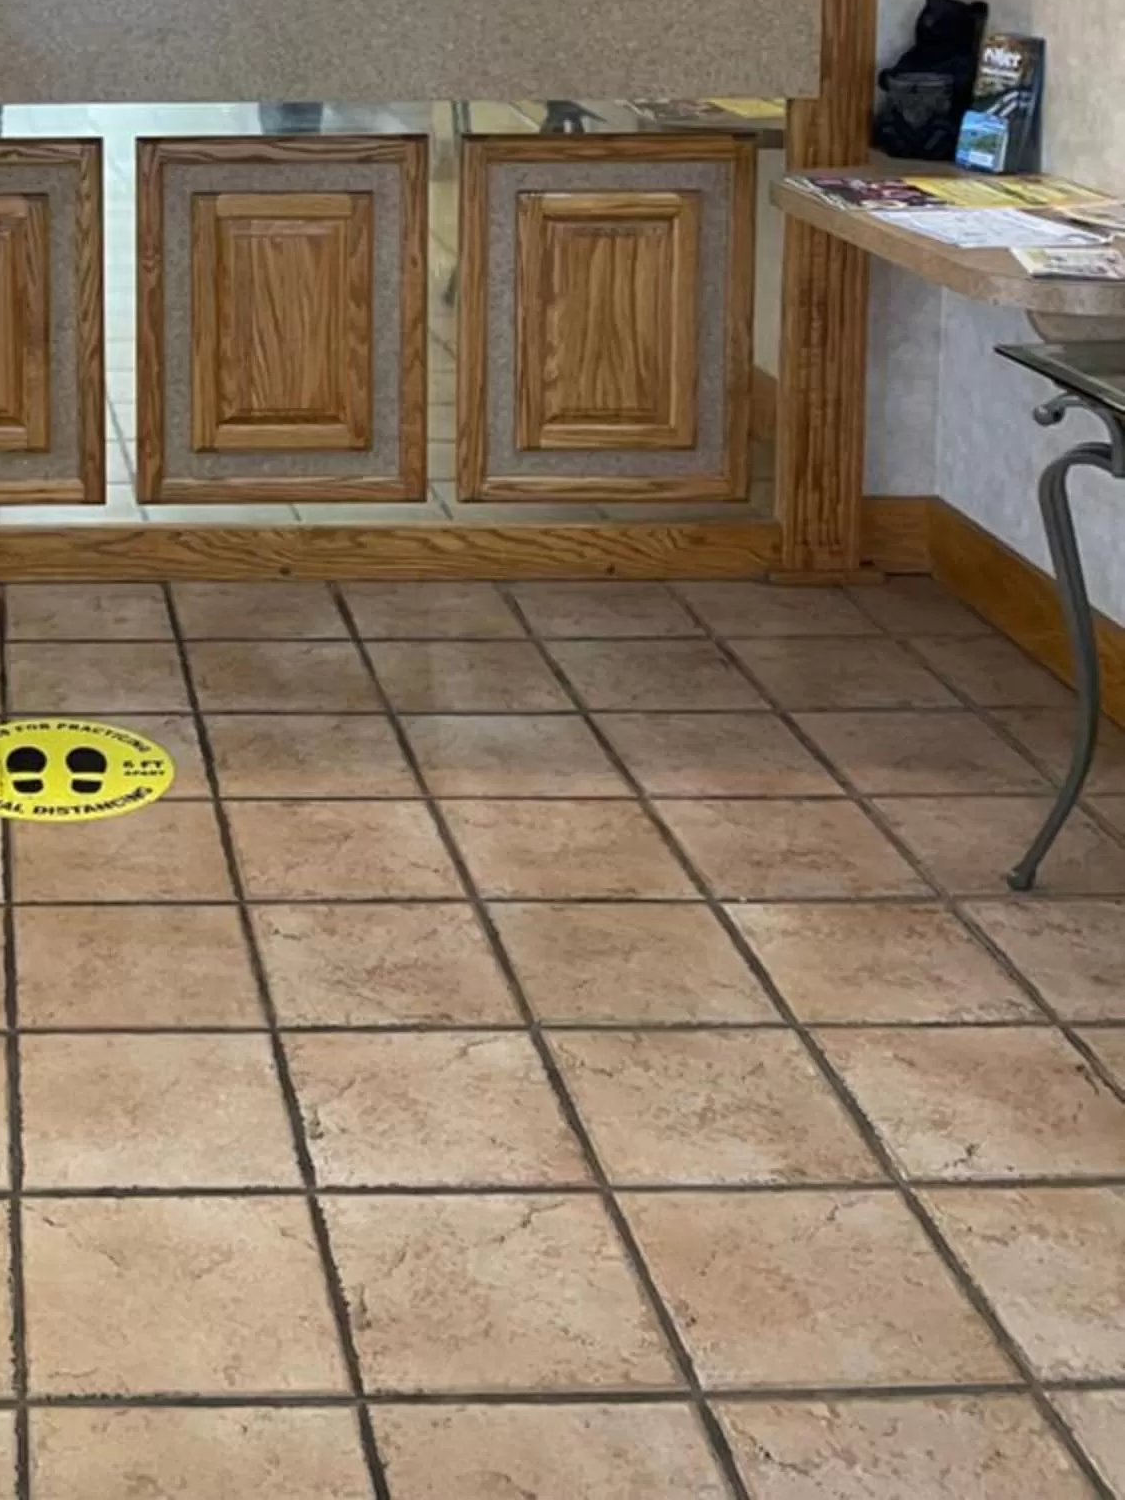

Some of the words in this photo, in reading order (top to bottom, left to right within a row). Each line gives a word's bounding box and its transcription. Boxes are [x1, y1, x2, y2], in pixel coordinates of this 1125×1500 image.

[15, 723, 51, 733] FOR
[56, 722, 152, 753] PRACTICING
[140, 760, 164, 769] FT
[32, 786, 153, 816] DISTANCING
